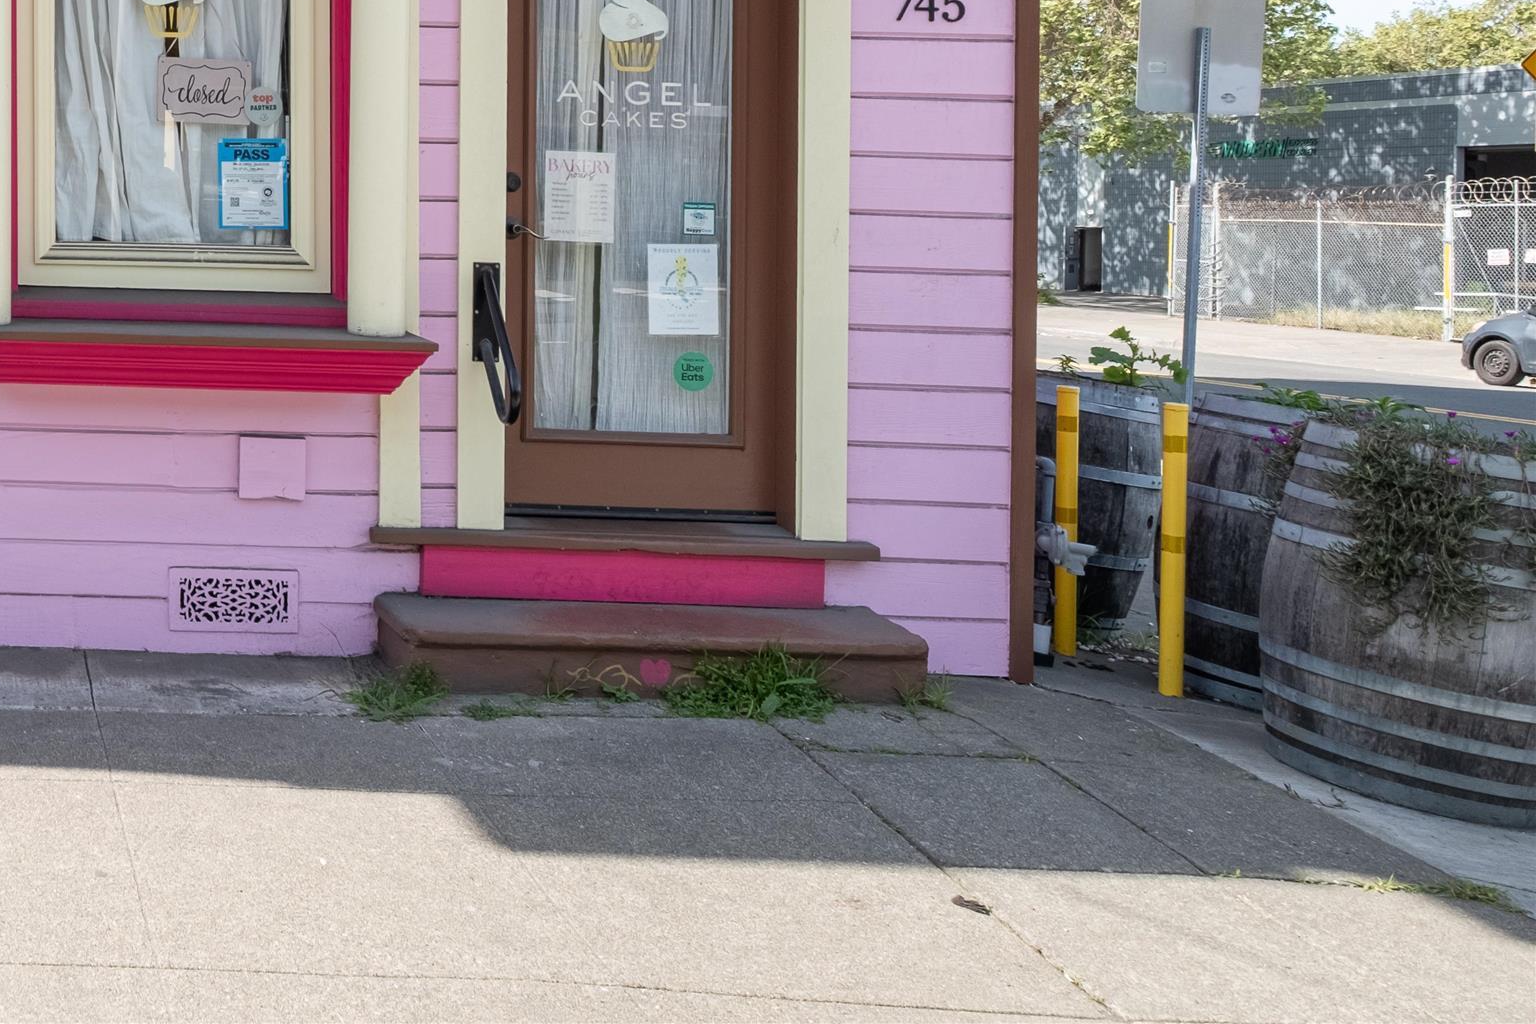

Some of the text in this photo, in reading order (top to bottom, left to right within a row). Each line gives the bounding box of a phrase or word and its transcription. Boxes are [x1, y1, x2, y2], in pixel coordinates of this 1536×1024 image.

[167, 74, 241, 105] closed
[556, 79, 712, 107] ANGEL
[579, 110, 688, 129] CAKES
[233, 149, 270, 160] PASS
[681, 363, 704, 373] Uber
[681, 372, 705, 382] Eats
